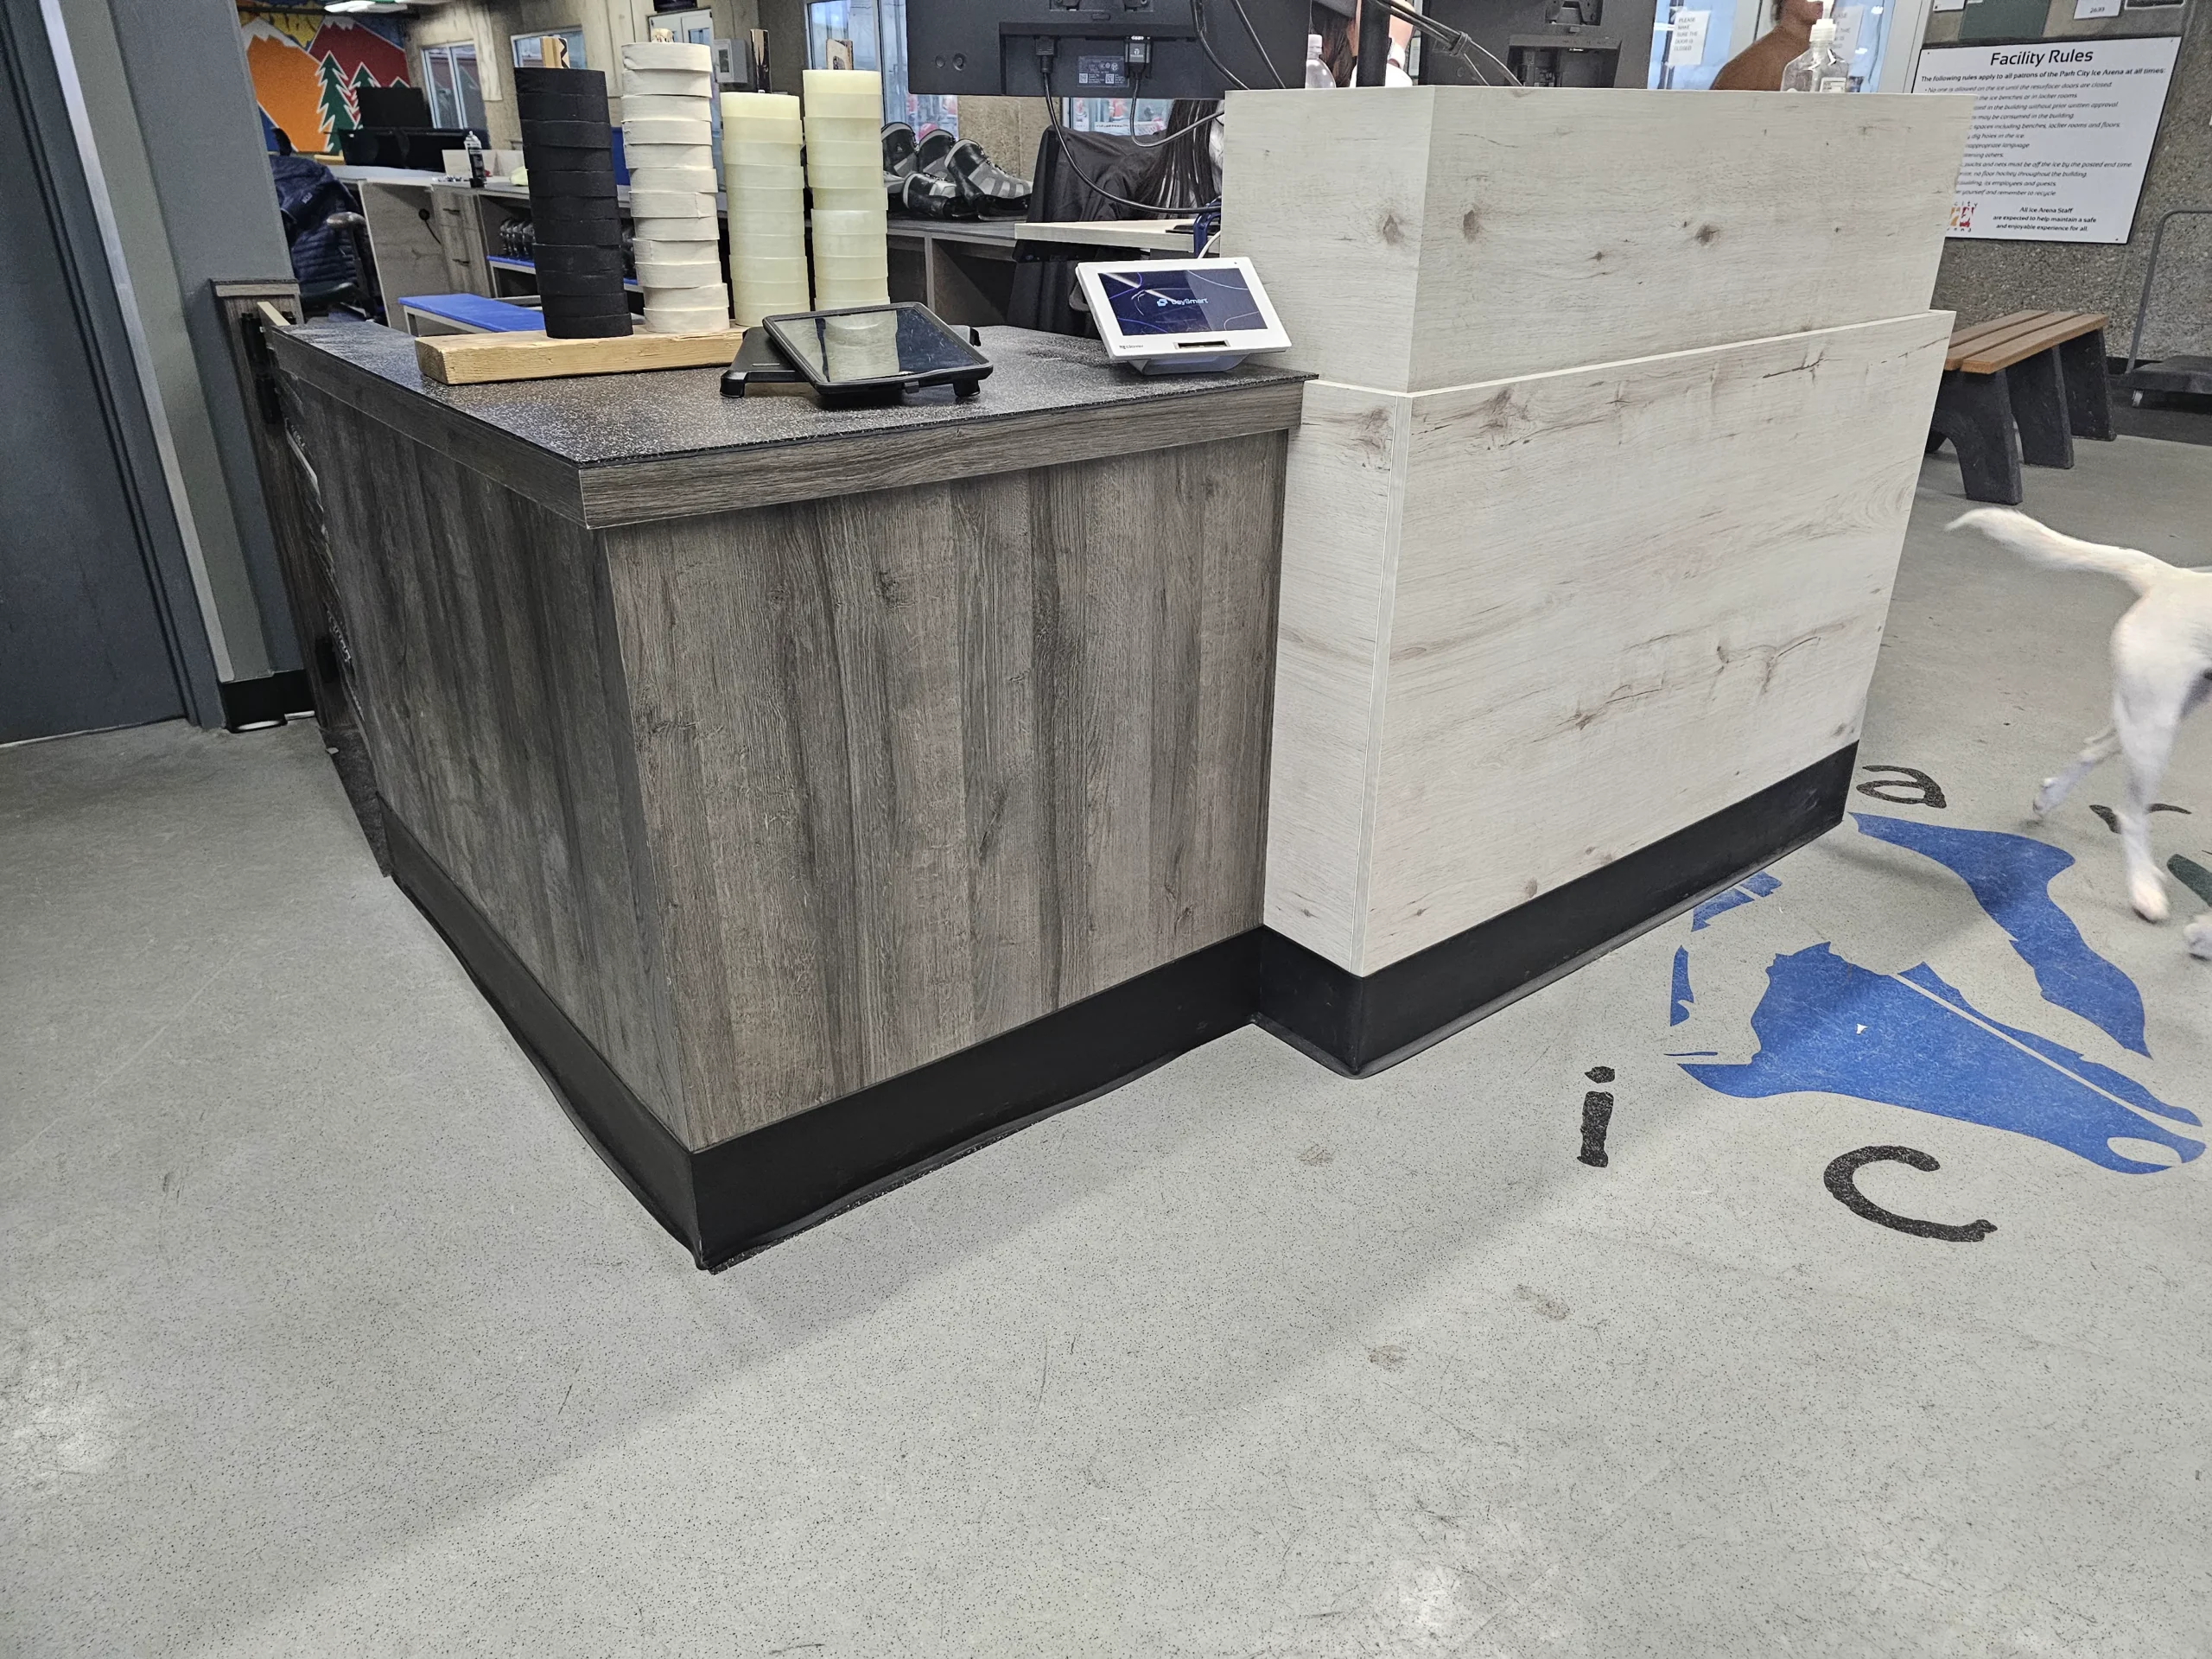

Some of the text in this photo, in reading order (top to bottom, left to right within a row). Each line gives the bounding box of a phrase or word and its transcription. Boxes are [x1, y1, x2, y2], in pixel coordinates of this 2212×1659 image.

[1990, 49, 2094, 67] Facility Rules
[2076, 69, 2090, 78] City
[1575, 1065, 1618, 1168] i
